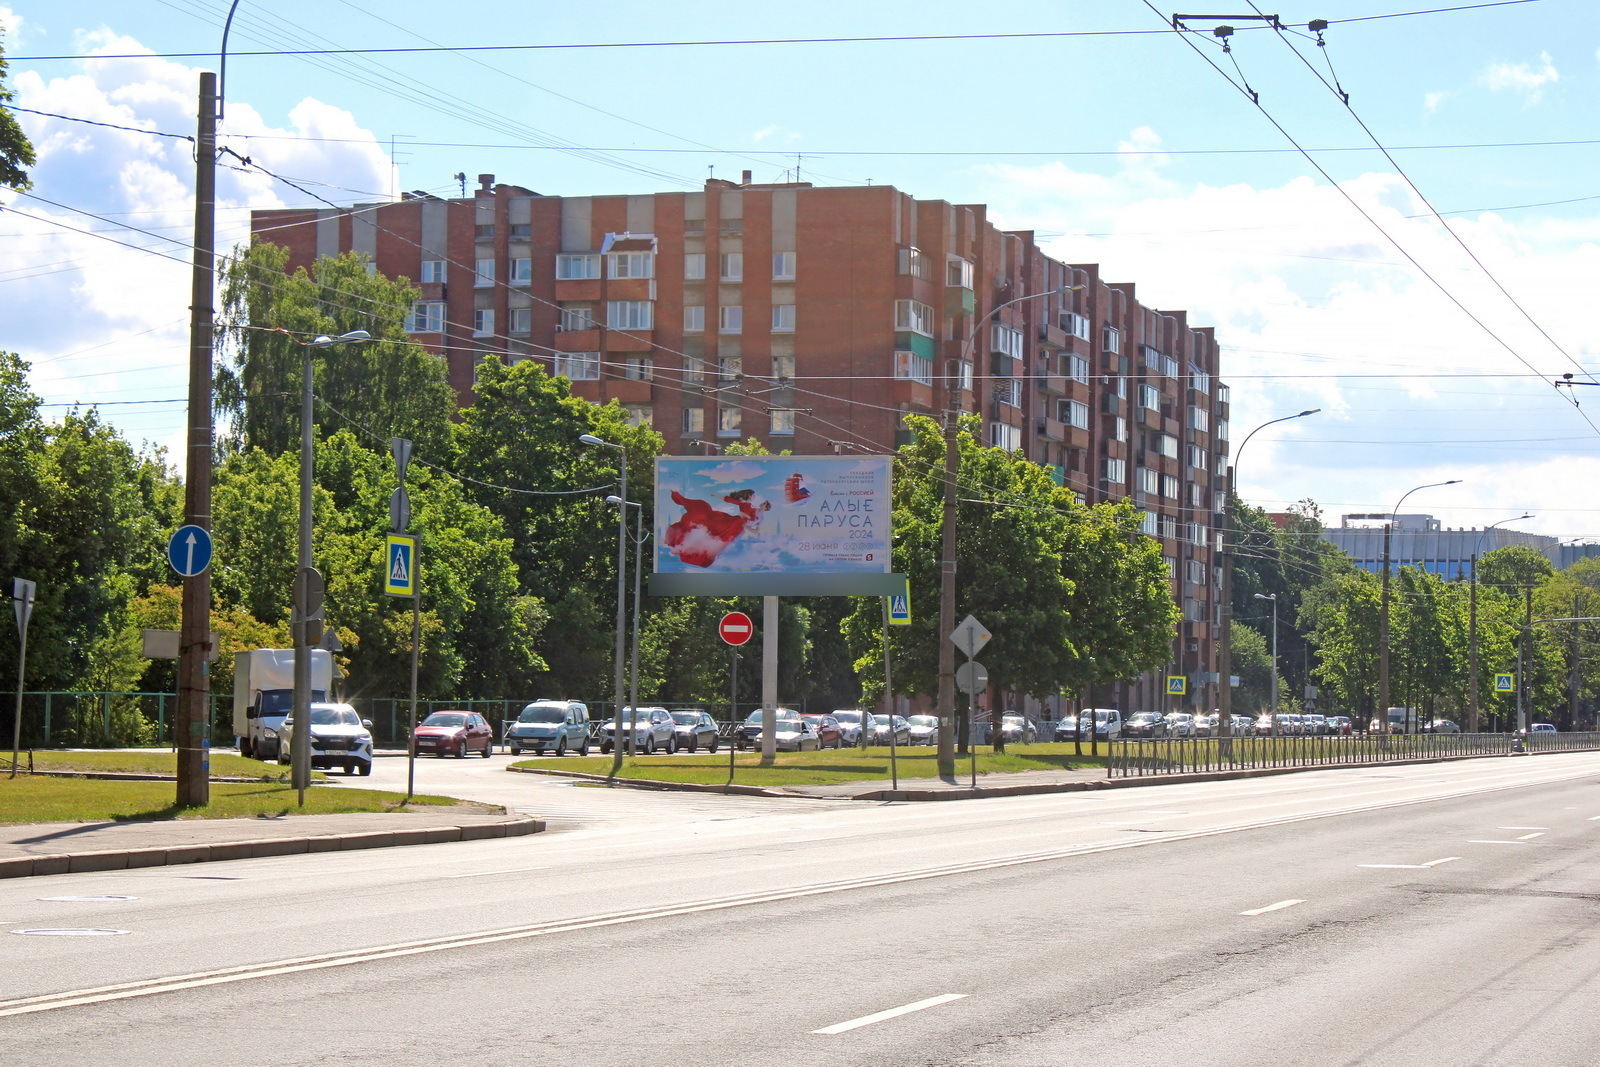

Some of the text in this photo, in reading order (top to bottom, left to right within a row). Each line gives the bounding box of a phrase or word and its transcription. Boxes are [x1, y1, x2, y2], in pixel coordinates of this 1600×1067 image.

[820, 499, 873, 512] АЛЫЕ
[798, 514, 873, 528] ПАРУСА
[848, 530, 873, 539] 2024
[798, 542, 810, 551] 28
